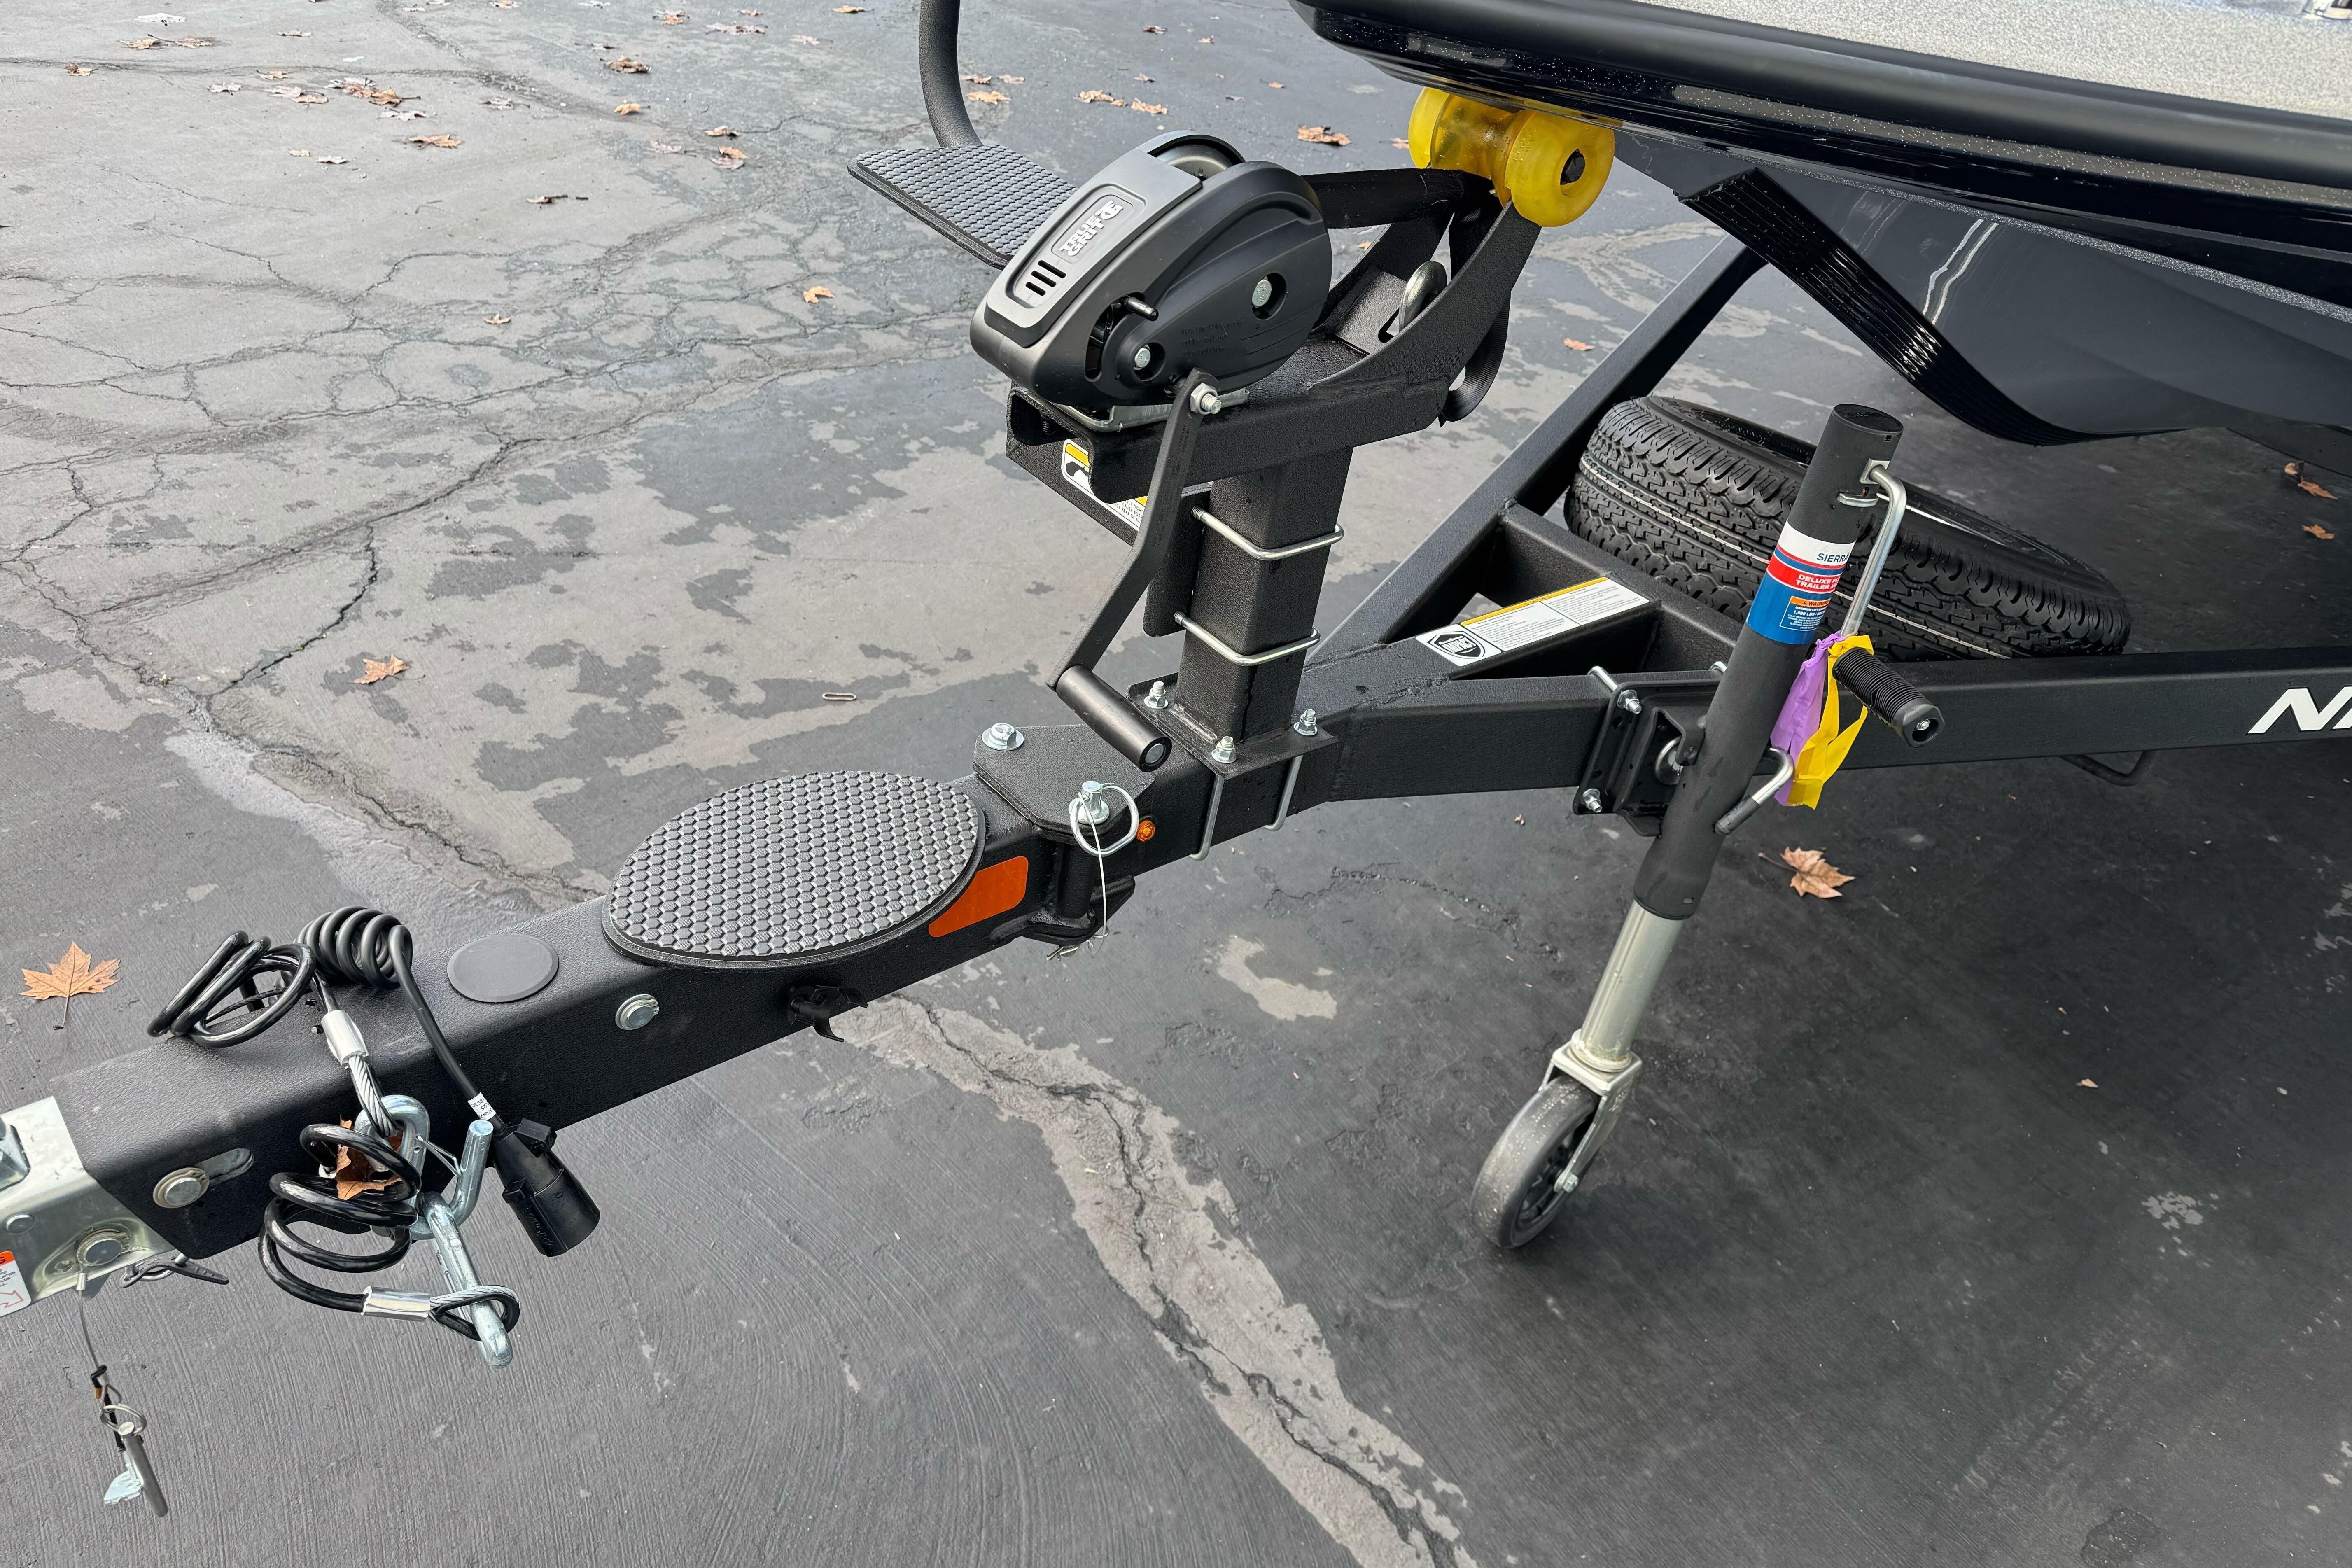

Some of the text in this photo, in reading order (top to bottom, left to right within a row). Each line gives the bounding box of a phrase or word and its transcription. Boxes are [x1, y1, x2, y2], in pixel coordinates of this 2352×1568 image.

[1059, 215, 1099, 252] TRUE
[1067, 217, 1104, 257] GRIT
[1796, 579, 1830, 590] TRAILER
[1798, 574, 1832, 584] DELUXE
[1441, 637, 1477, 654] IMPACT
